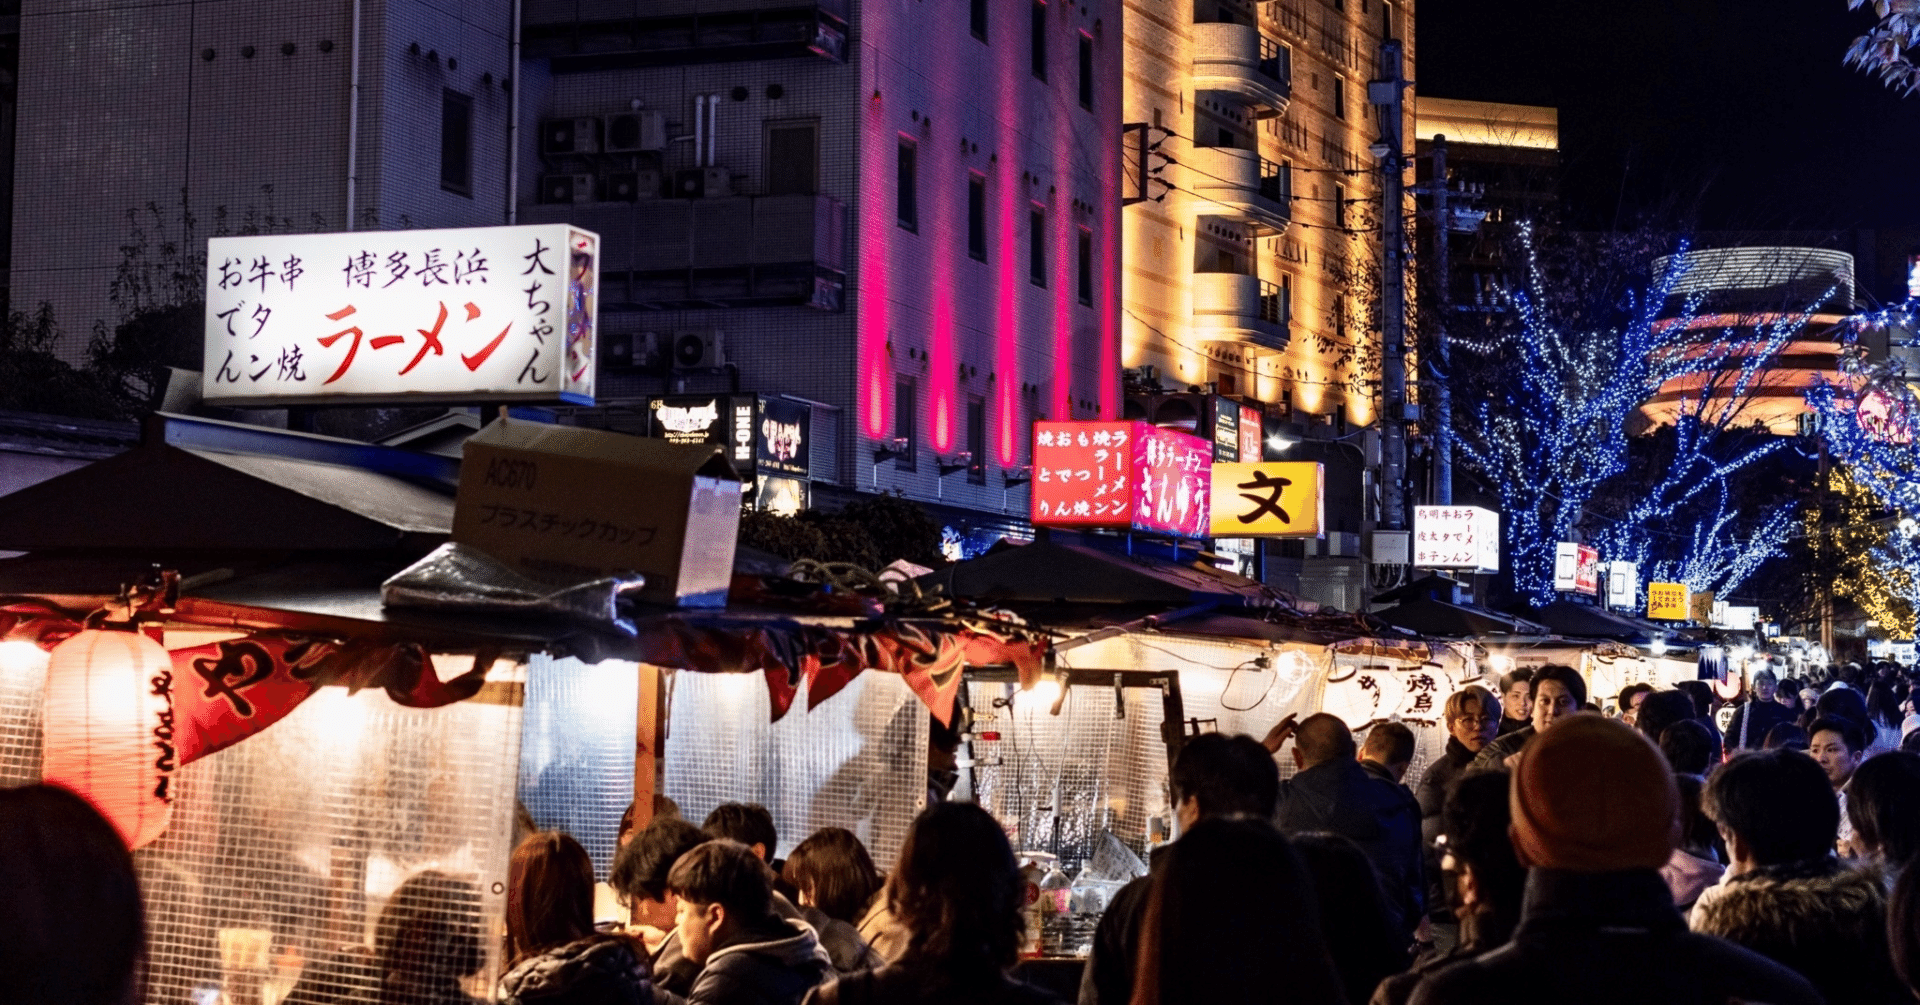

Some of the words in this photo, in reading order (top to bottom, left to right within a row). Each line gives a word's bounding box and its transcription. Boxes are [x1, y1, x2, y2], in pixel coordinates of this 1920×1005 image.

[342, 247, 490, 289] 博多長浜
[215, 256, 247, 384] おでん
[247, 255, 276, 383] 牛タン
[277, 253, 307, 383] 串焼
[317, 300, 515, 387] ラーメン
[516, 238, 556, 385] 大ちゃん
[485, 457, 537, 491] AC670
[735, 406, 751, 461] H-ONE
[1037, 430, 1055, 516] 焼とり
[1055, 430, 1072, 516] おでん
[1073, 430, 1091, 516] もつ焼
[1093, 430, 1111, 515] 焼ラーメン
[1110, 430, 1128, 515] ラーメン
[480, 504, 658, 548] プラスチックカップ
[1237, 470, 1292, 524] 文
[1441, 509, 1451, 563] 牛タン
[1452, 509, 1462, 562] おでん
[1464, 509, 1474, 563] ラーメン
[1405, 673, 1438, 713] 焼鳥
